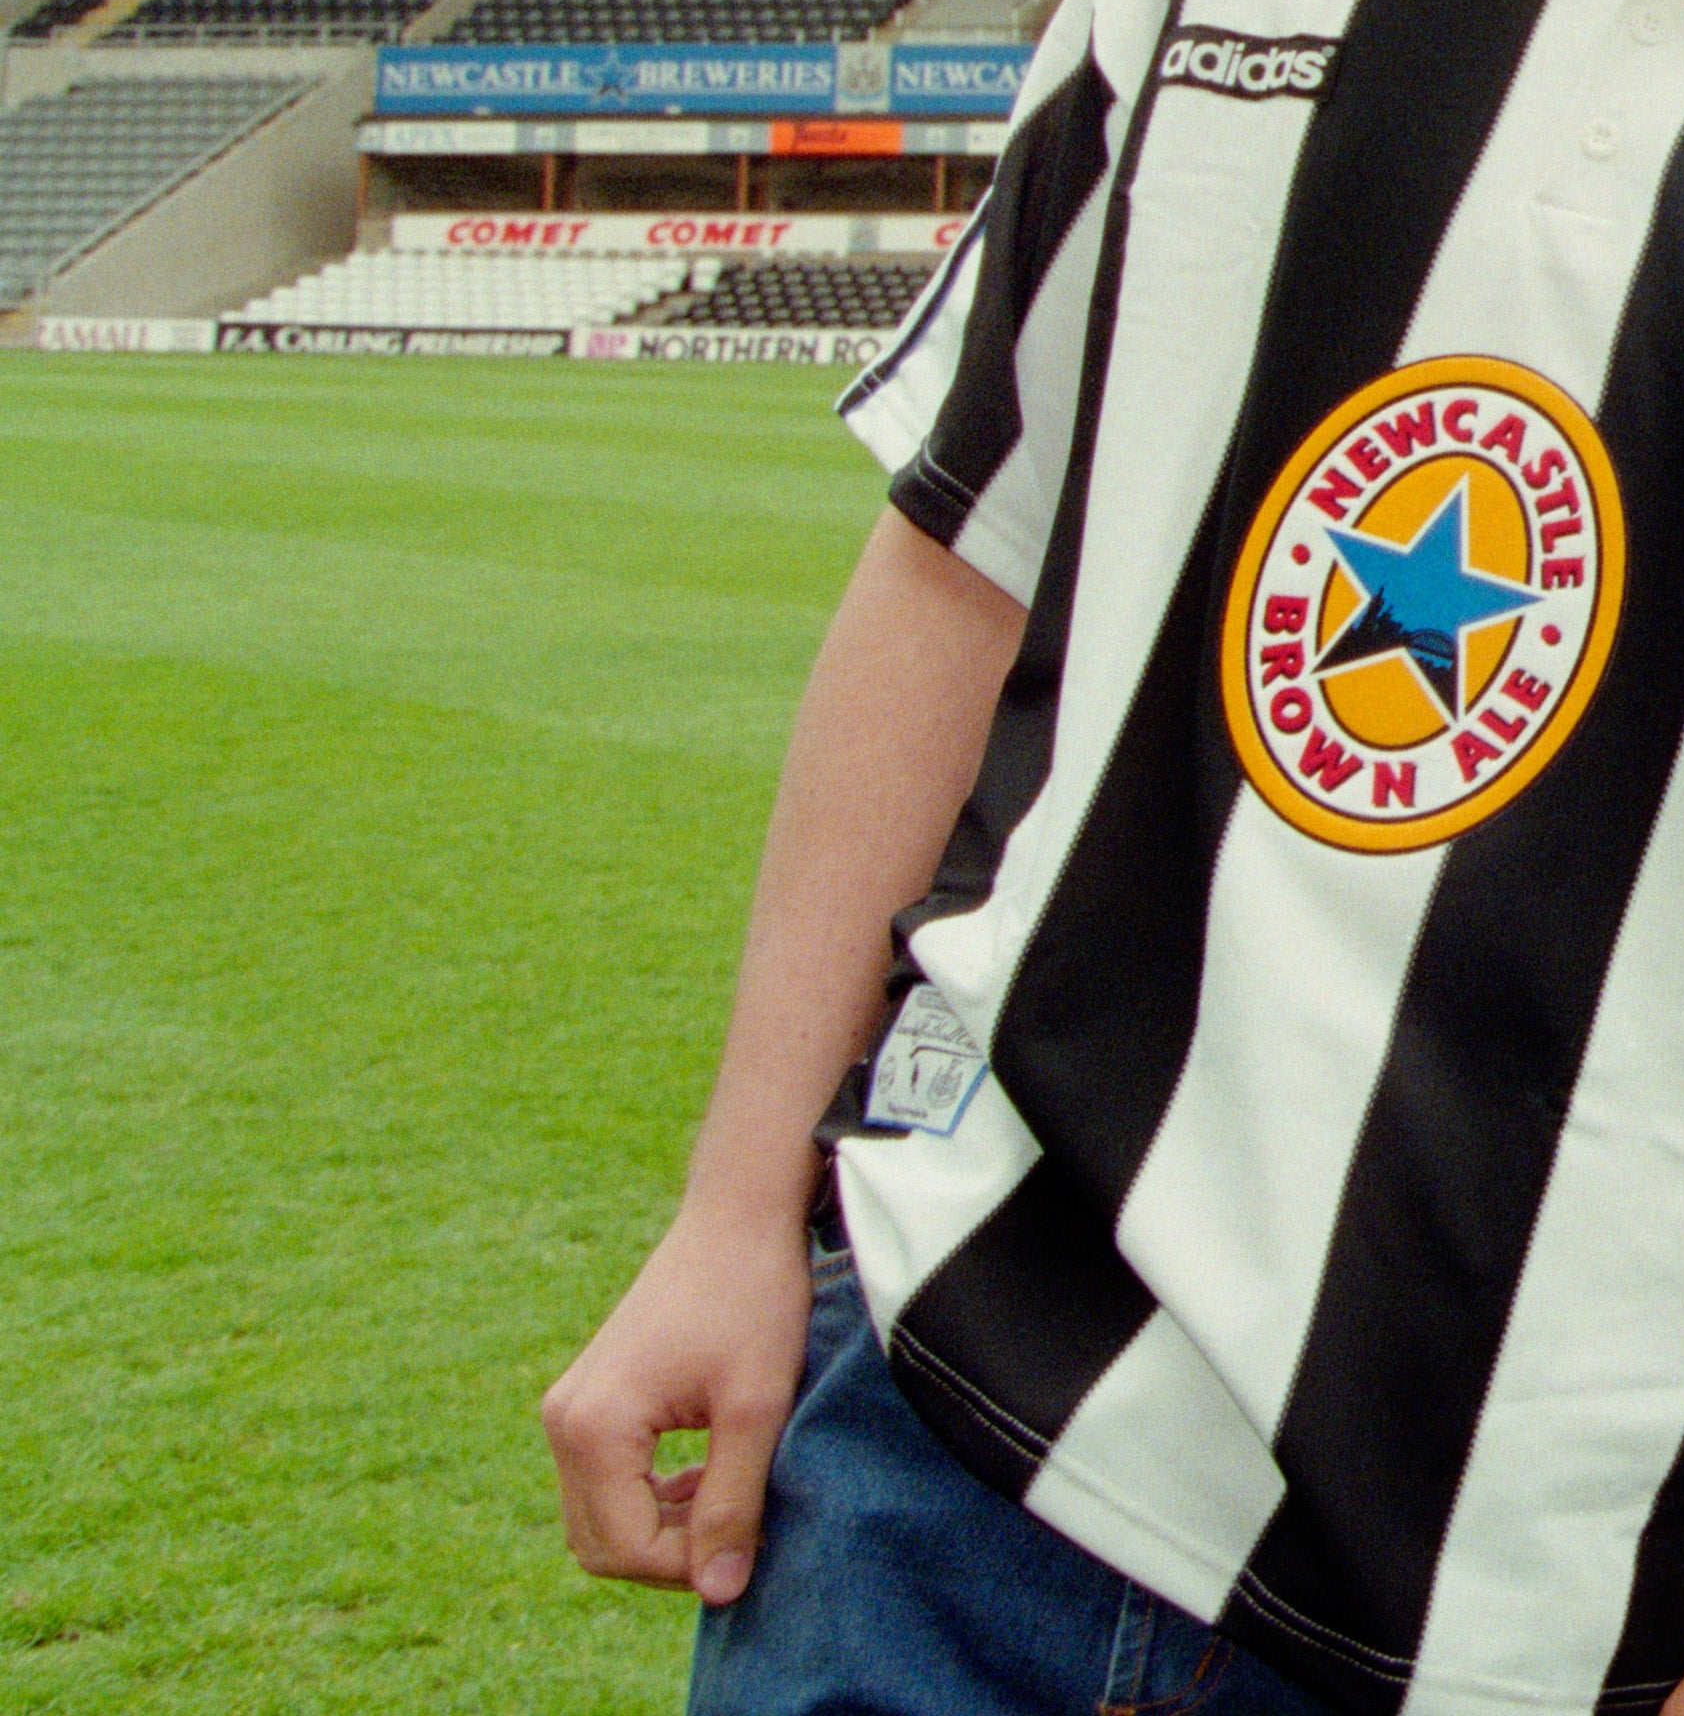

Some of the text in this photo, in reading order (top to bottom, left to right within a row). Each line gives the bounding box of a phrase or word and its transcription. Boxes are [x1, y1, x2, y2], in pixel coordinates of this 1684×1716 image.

[383, 61, 834, 88] NEWCASTLE BREWERIES
[895, 61, 1027, 88] NEWCAS
[1160, 38, 1329, 92] adidas
[447, 219, 793, 246] COMET COMET
[275, 324, 403, 353] CARLING
[639, 335, 818, 364] NORTHERN
[831, 337, 881, 364] RO
[1305, 398, 1586, 591] NEWCASTLE
[1260, 593, 1552, 808] BROWN ALE
